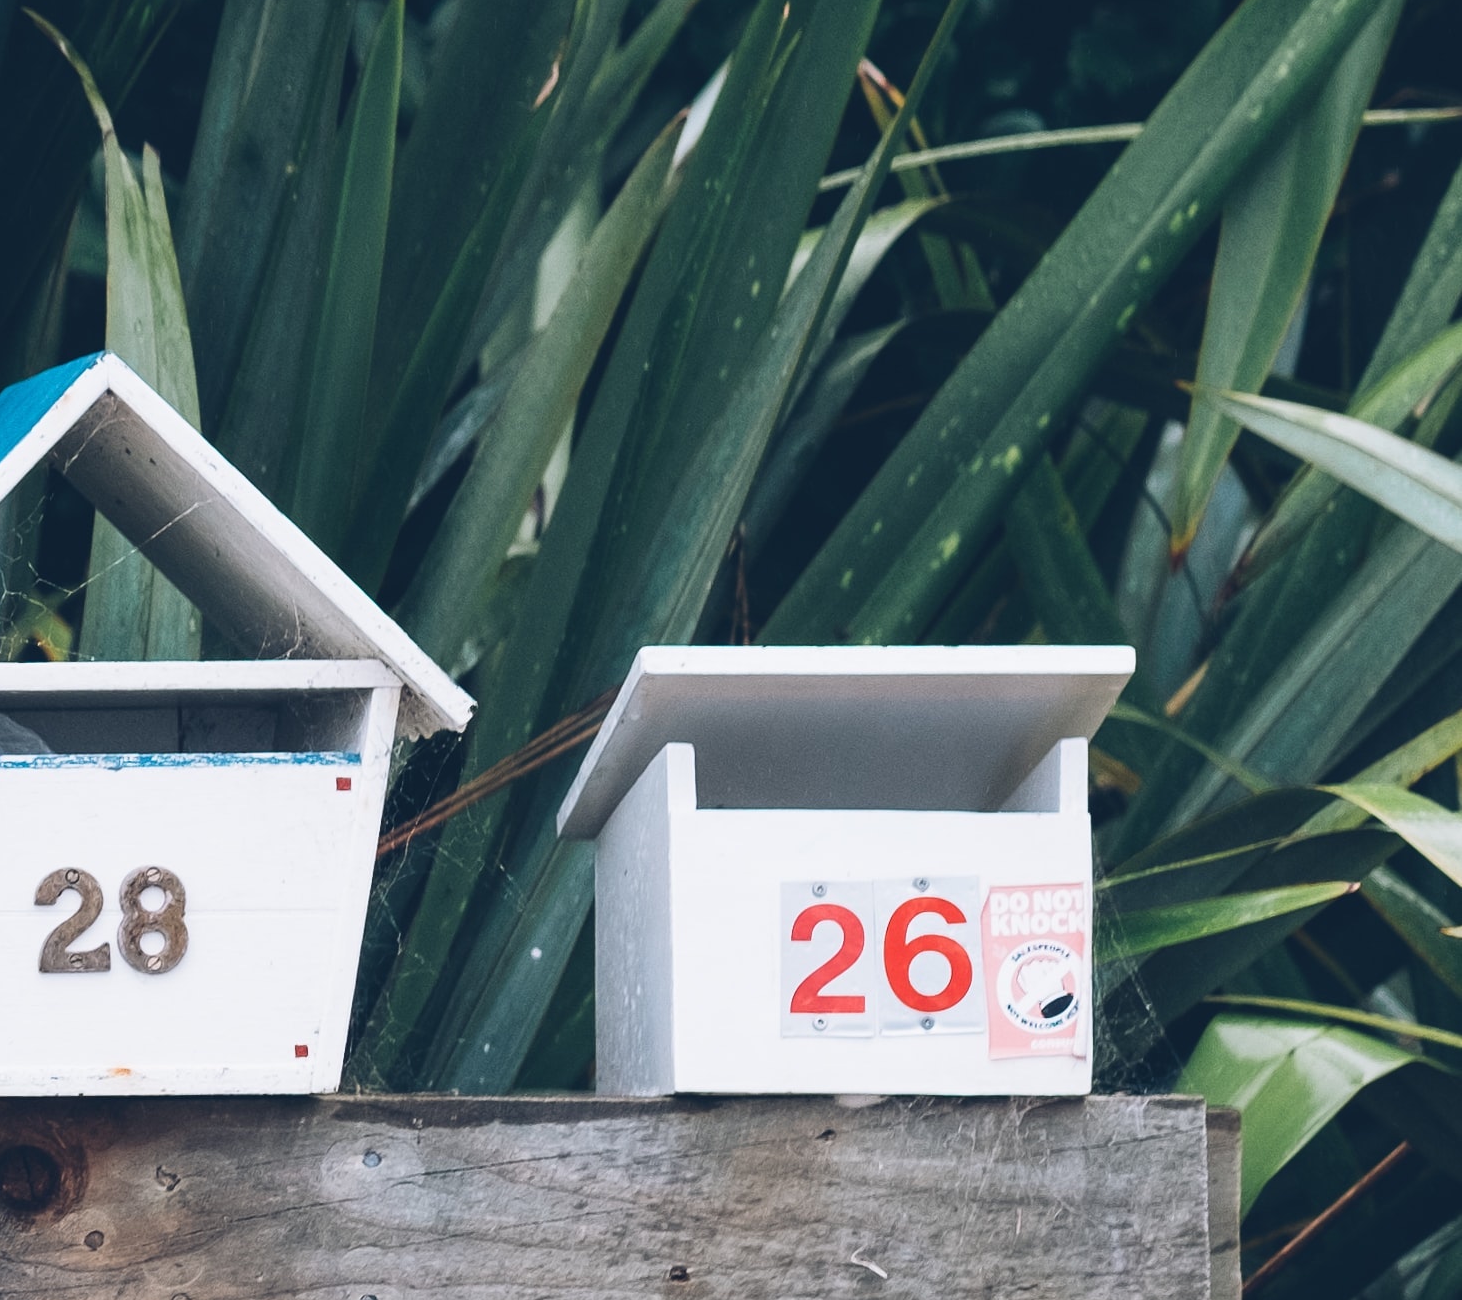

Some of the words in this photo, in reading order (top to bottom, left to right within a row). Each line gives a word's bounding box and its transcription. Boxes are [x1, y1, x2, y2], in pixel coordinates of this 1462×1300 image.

[33, 866, 190, 976] 28
[990, 891, 1030, 914] DO
[1033, 888, 1083, 912] NOT
[990, 911, 1085, 936] KNOCK
[790, 896, 973, 1014] 26
